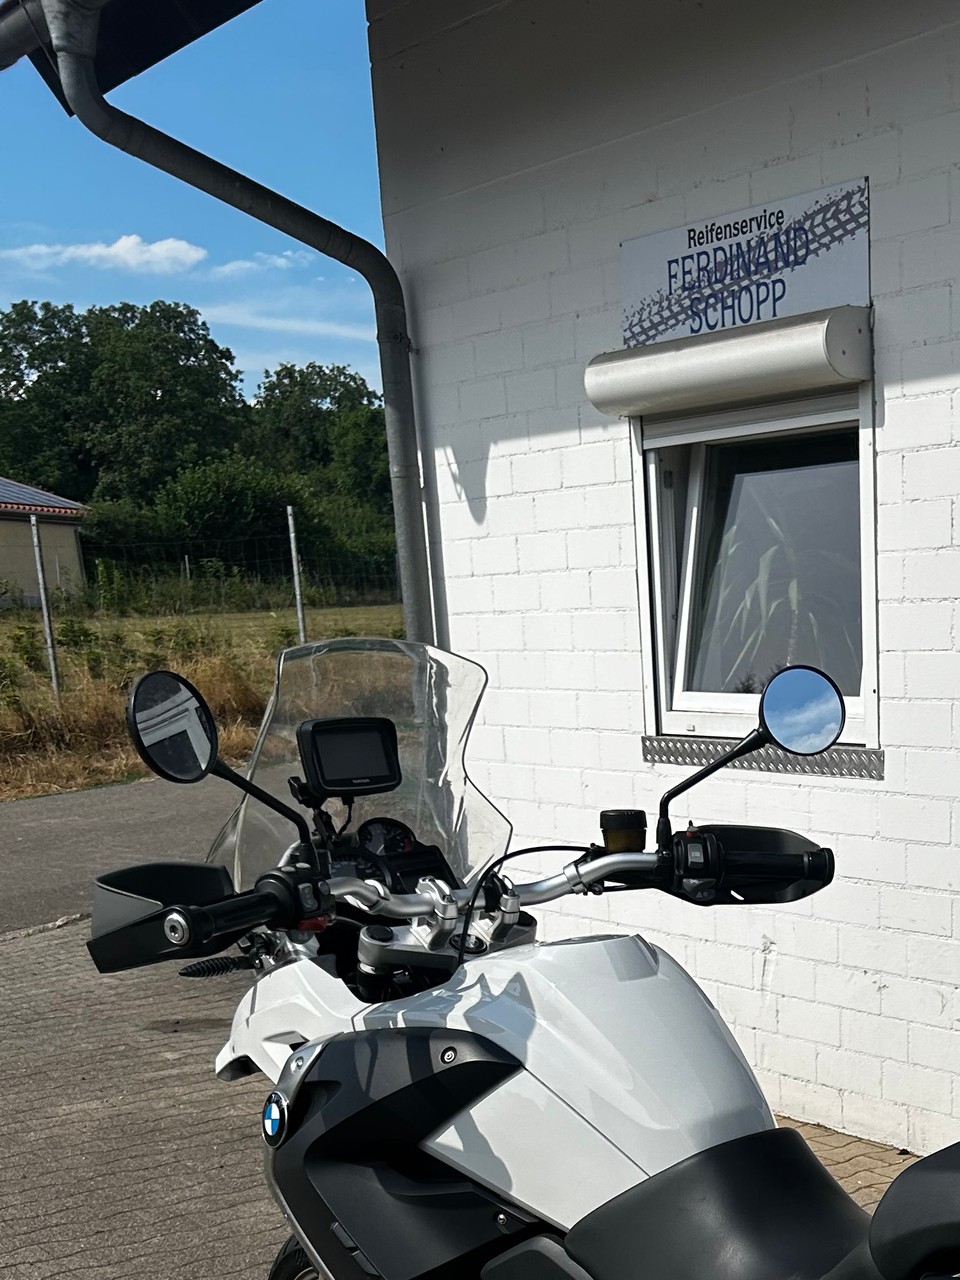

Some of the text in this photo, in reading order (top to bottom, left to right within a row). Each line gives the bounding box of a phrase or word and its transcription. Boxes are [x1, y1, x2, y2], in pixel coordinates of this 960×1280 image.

[687, 209, 785, 249] Reifenservice
[667, 226, 809, 296] FERDINAND
[690, 278, 786, 334] SCHOPP
